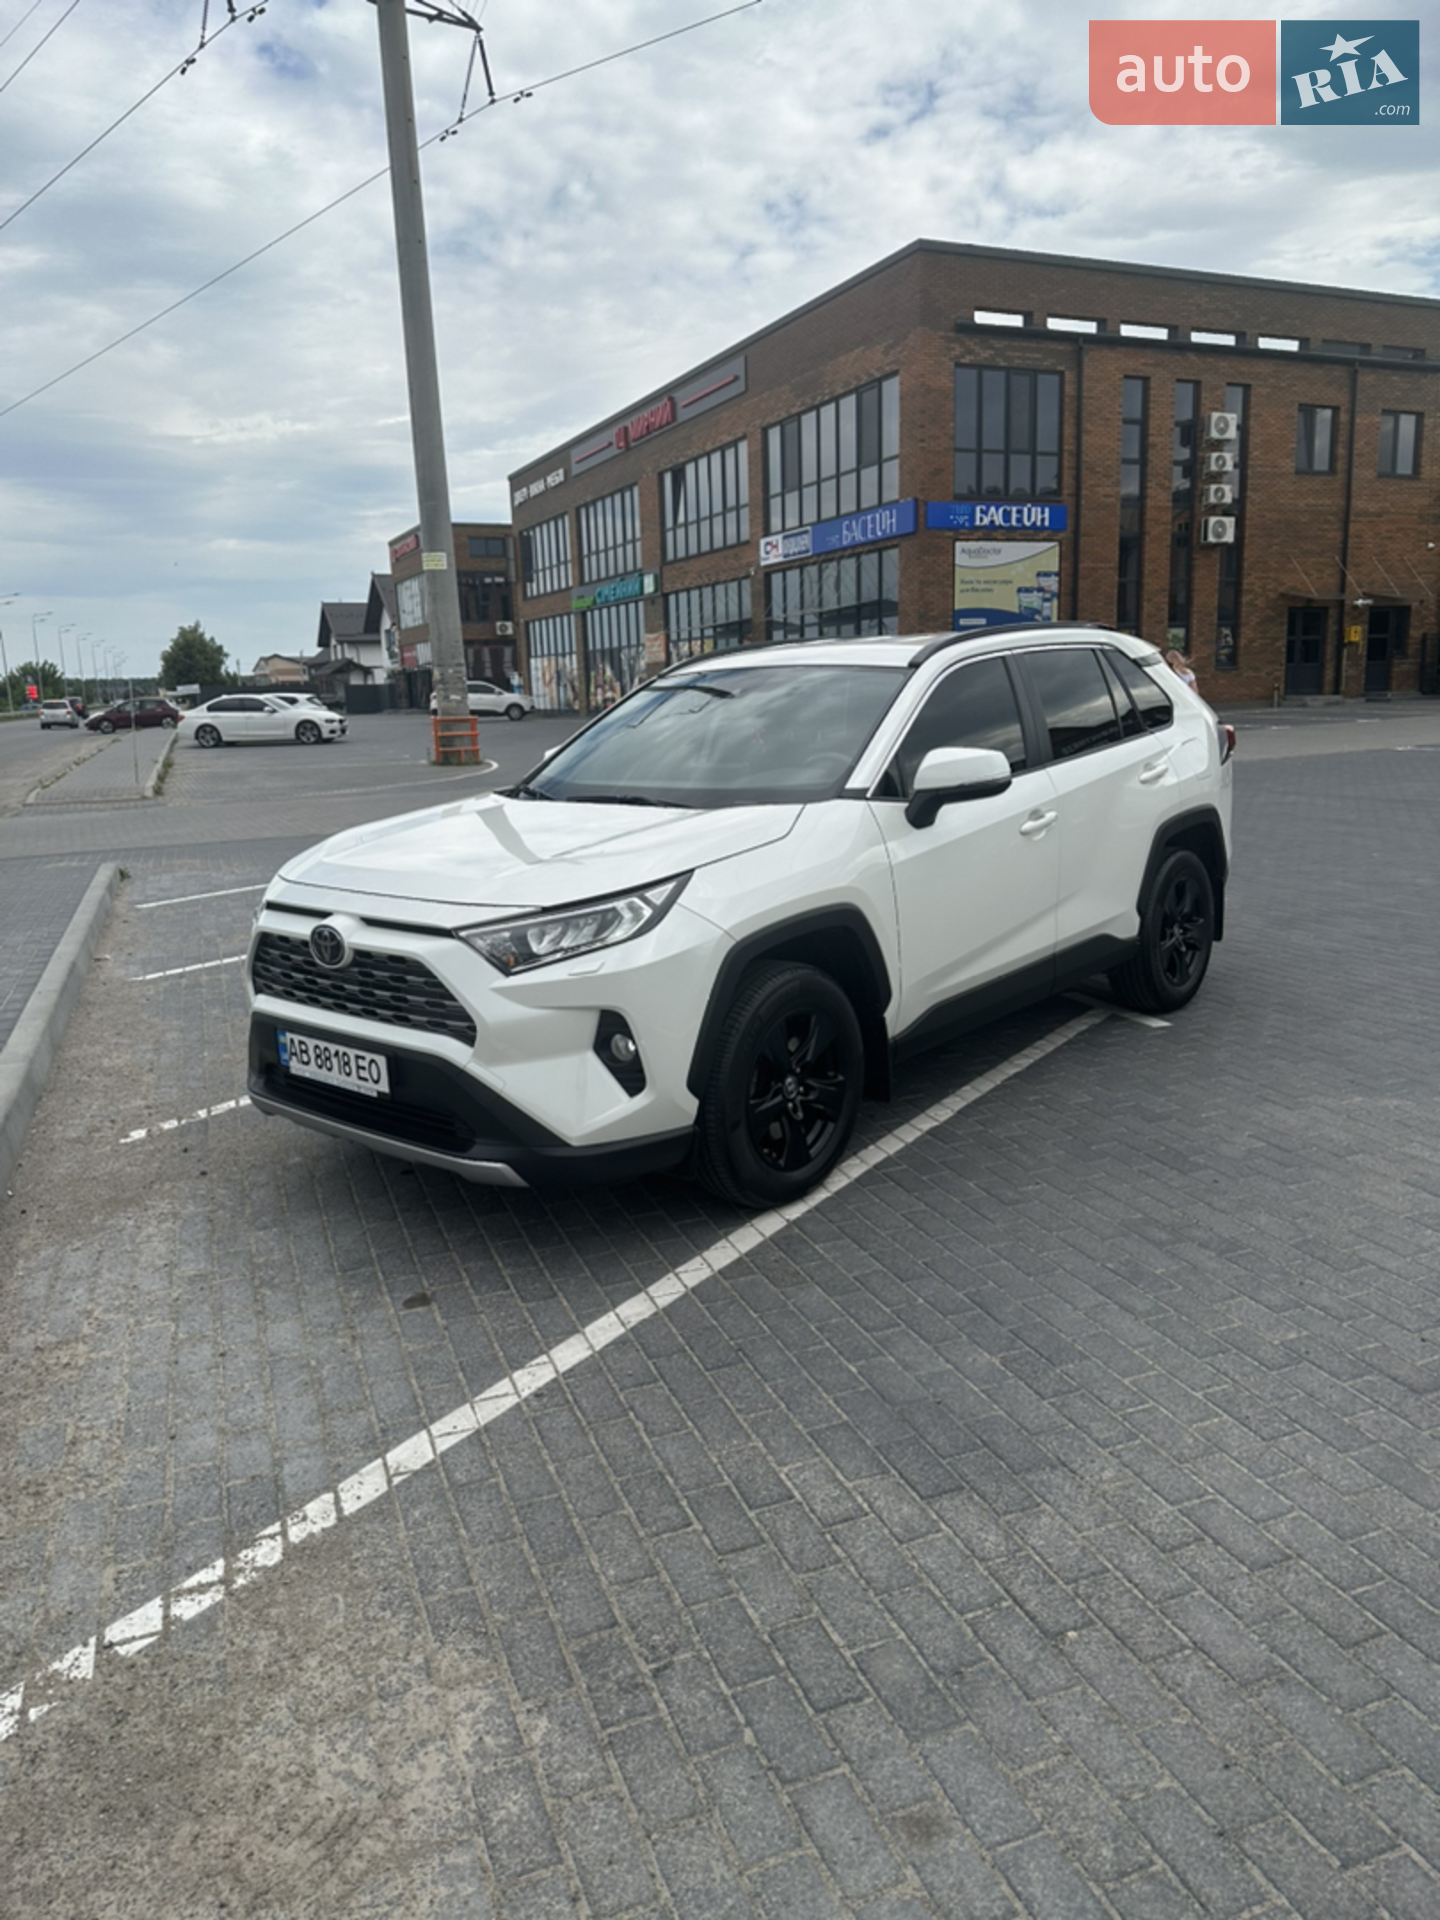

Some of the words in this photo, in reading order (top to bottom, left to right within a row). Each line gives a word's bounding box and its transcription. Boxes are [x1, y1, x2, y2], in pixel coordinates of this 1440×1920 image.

[841, 508, 897, 546] БАСЕЙН
[974, 503, 1050, 527] БАСЕЙН
[289, 1037, 312, 1066] AB
[314, 1044, 352, 1077] 8818
[354, 1053, 382, 1085] EO
